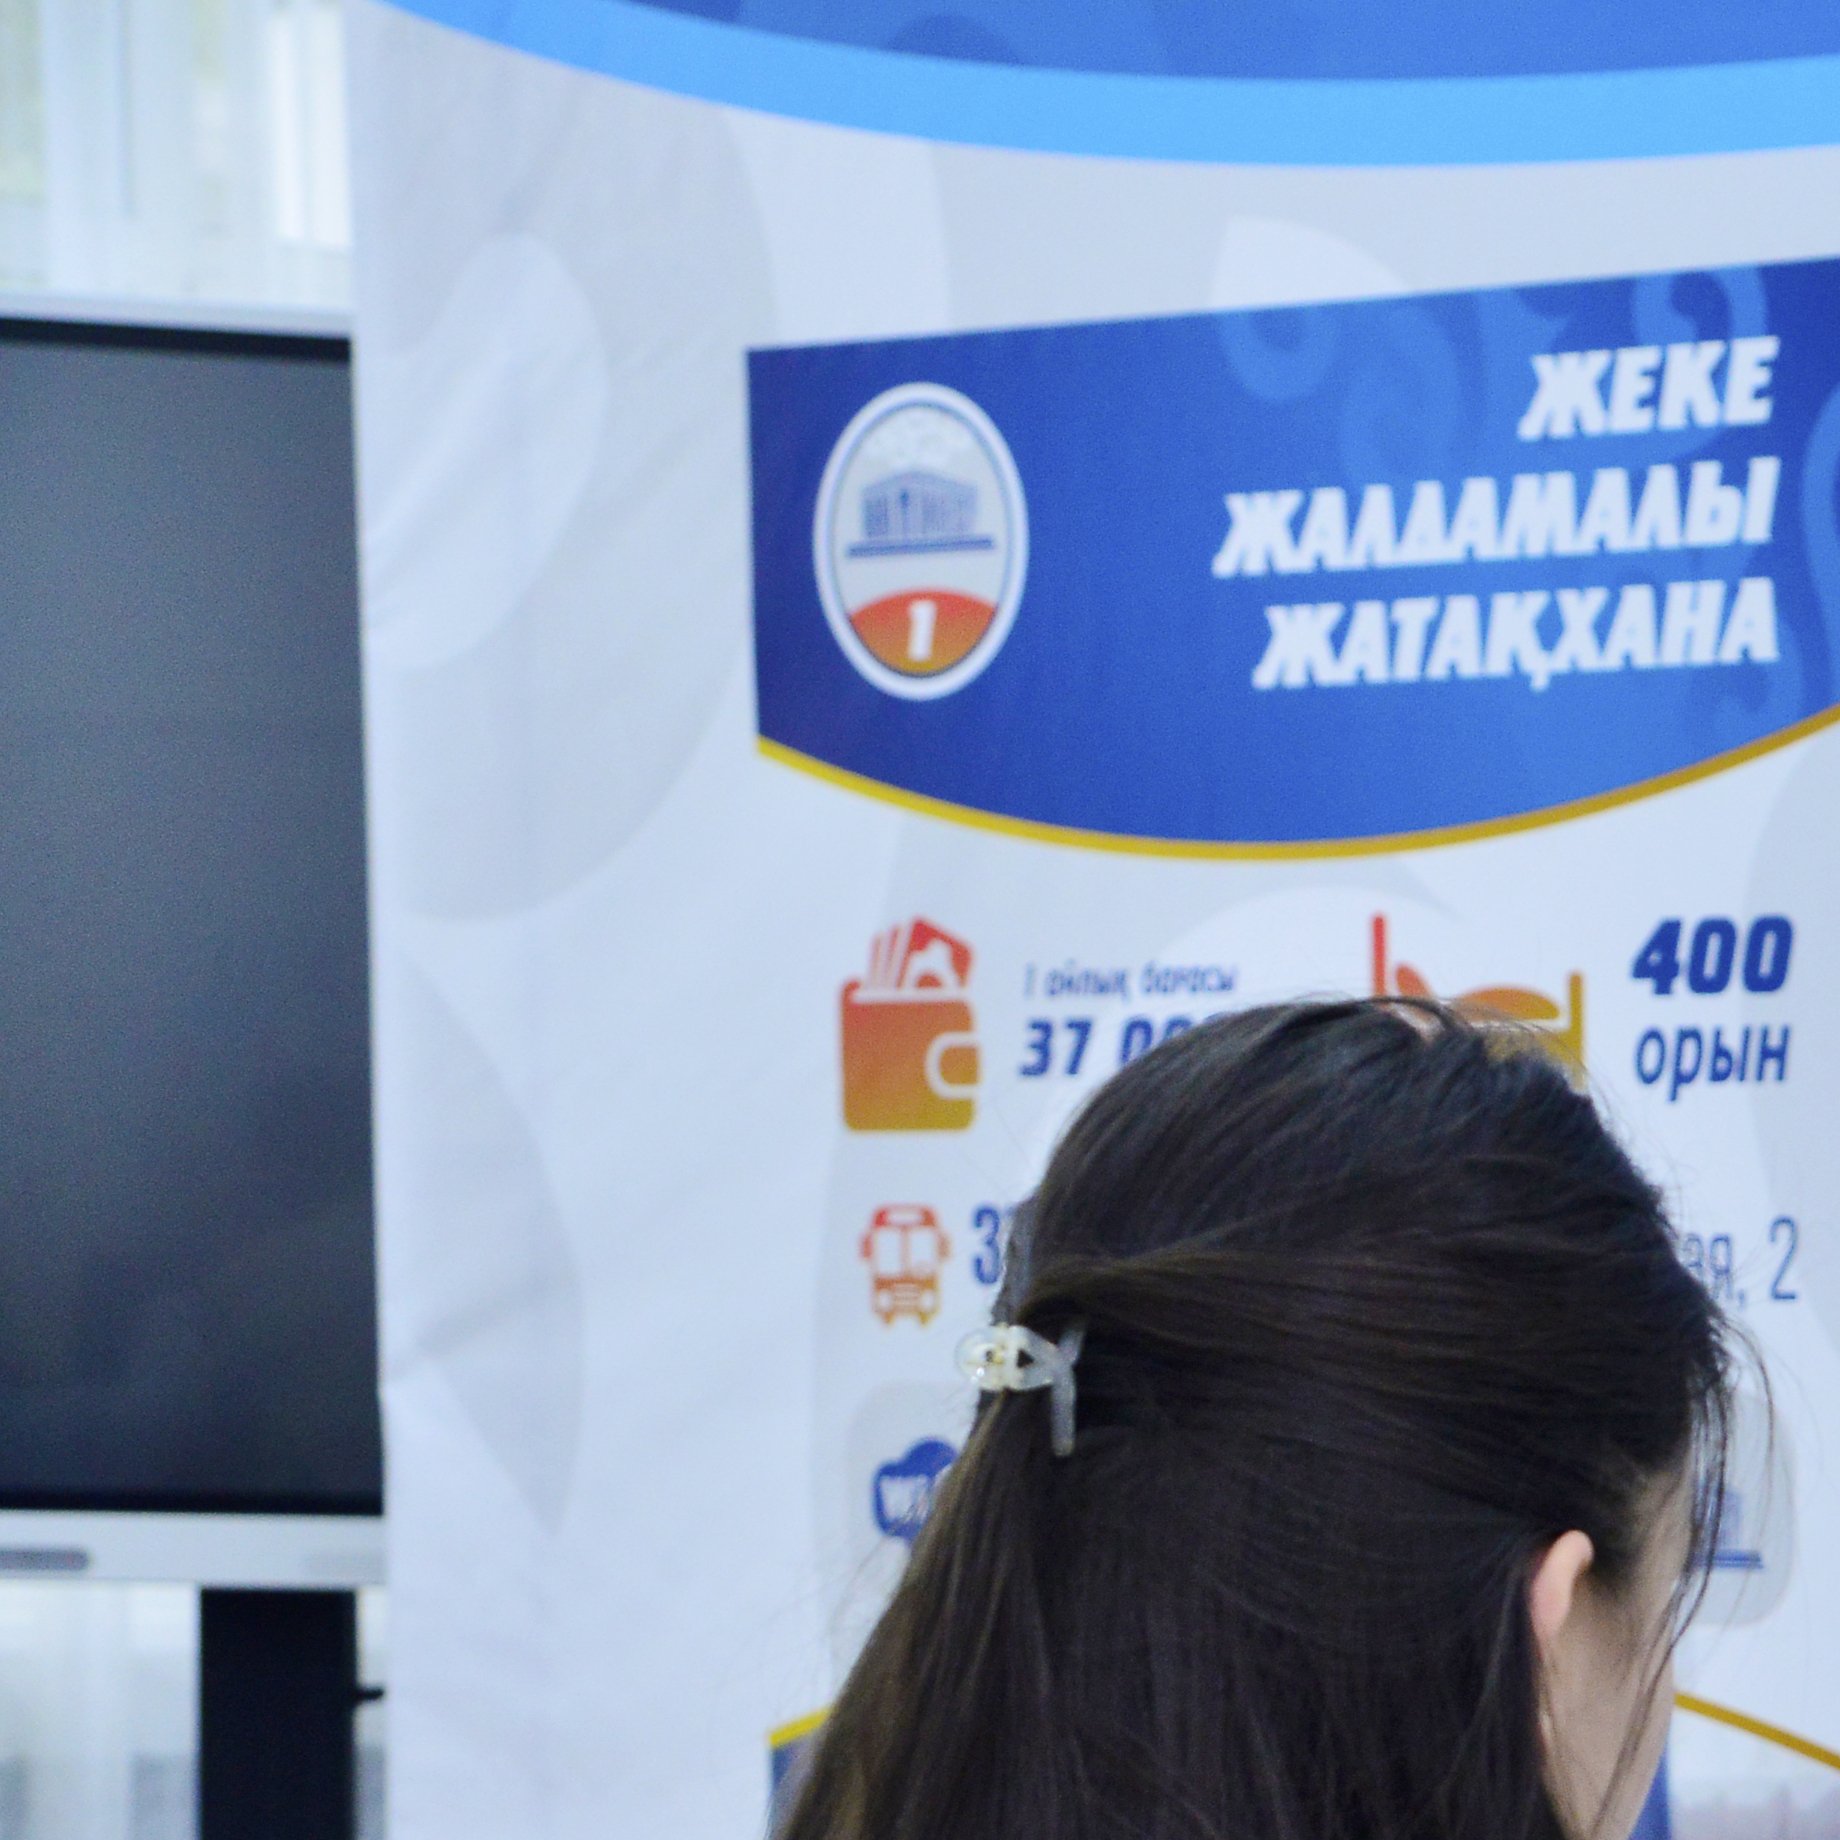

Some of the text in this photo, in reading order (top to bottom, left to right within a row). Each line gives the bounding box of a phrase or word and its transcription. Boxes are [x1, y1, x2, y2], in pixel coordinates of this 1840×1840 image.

[1516, 334, 1781, 442] ЖЕКЕ
[1211, 457, 1781, 579] ЖАЛДАМАЛЫ
[904, 599, 936, 663] 1
[1251, 577, 1781, 691] ЖАТАҚХАНА
[1631, 916, 1794, 996] 400
[1019, 1016, 1094, 1077] 37
[1635, 1023, 1791, 1102] орын
[1769, 1214, 1799, 1301] 2
